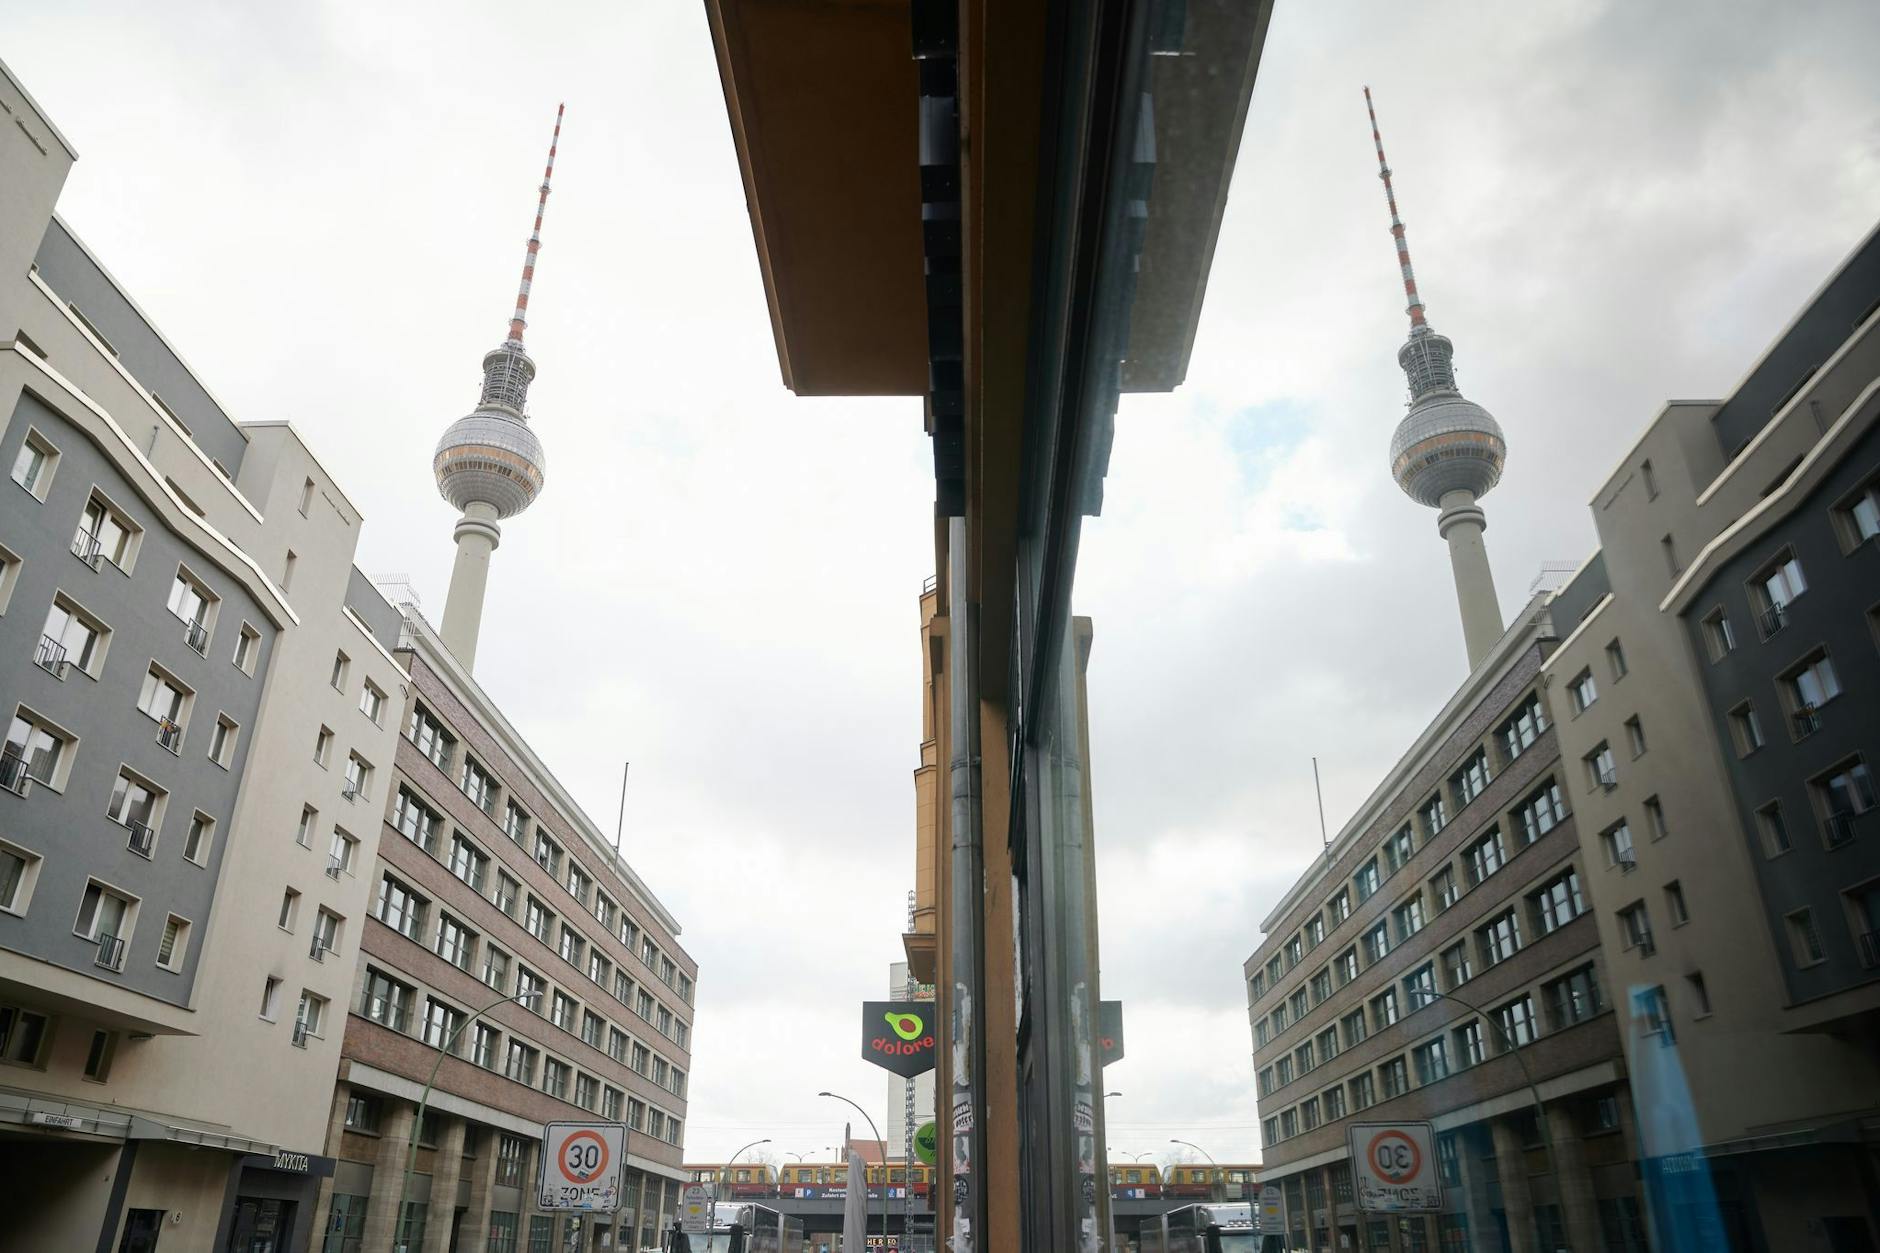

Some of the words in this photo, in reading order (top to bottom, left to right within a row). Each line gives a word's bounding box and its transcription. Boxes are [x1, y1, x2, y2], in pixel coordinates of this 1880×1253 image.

[872, 1035, 935, 1056] dolore
[45, 1115, 74, 1126] EINFAHRT
[273, 1153, 308, 1172] MYKITA
[568, 1145, 599, 1169] 30
